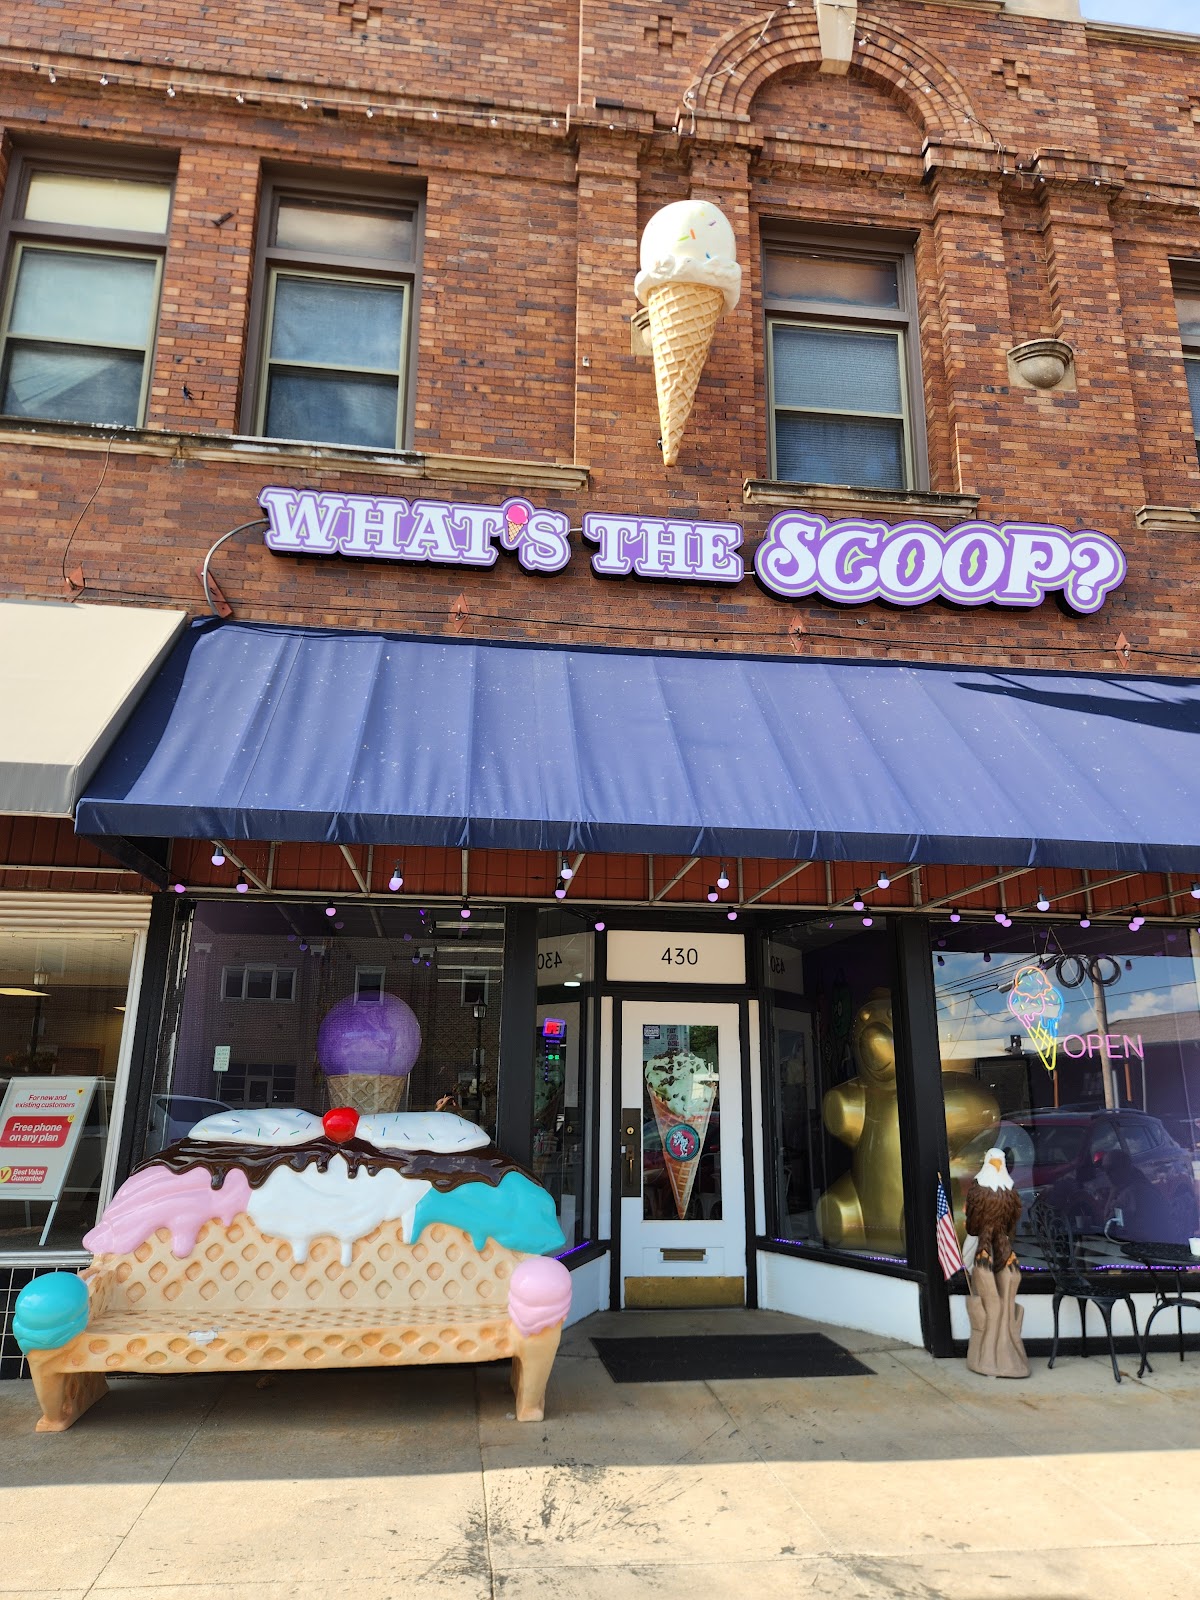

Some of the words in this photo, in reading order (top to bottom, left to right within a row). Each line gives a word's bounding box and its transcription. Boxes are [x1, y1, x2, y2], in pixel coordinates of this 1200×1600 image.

[589, 518, 741, 576] THE
[766, 521, 1115, 601] SCOOP?
[661, 947, 698, 965] 430
[1063, 1034, 1144, 1059] OPEN
[12, 1122, 33, 1131] Free
[33, 1123, 62, 1133] phone
[22, 1134, 39, 1143] any
[38, 1133, 58, 1143] plan
